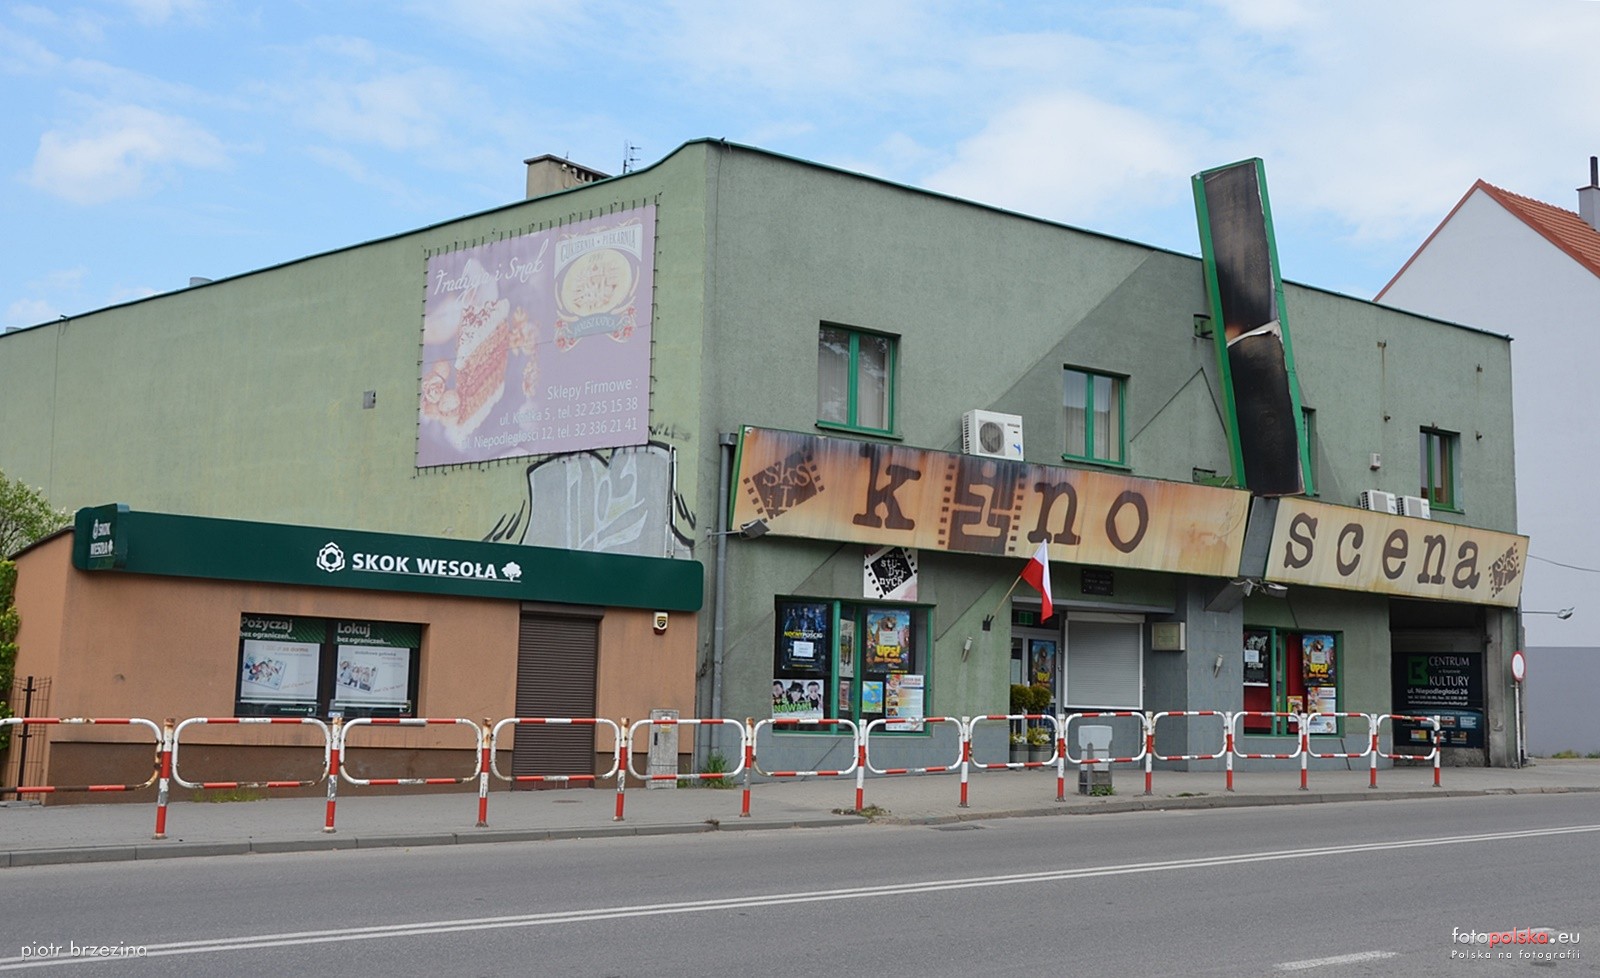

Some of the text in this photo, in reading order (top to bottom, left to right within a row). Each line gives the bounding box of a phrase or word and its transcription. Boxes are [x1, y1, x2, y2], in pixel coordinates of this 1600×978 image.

[505, 238, 549, 284] Smak
[547, 384, 581, 402] Sklepy
[584, 379, 633, 396] Firmowe
[500, 415, 511, 427] ul.
[557, 407, 572, 419] tel.
[574, 403, 589, 417] 32
[589, 401, 607, 415] 235
[611, 398, 622, 412] 15
[626, 396, 638, 411] 38
[557, 426, 572, 438] tel.
[574, 422, 588, 437] 32
[589, 421, 607, 435] 336
[610, 419, 622, 433] 21
[625, 417, 638, 431] 41
[852, 443, 1150, 555] kino
[1284, 512, 1481, 589] scena
[352, 553, 498, 579] SKOK WESOŁA
[240, 616, 293, 633] Pożyczaj
[337, 622, 371, 636] Lokuj
[336, 635, 349, 643] bez
[876, 645, 901, 658] UPS!
[1428, 655, 1470, 667] CENTRUM
[1429, 675, 1470, 687] KULTURY
